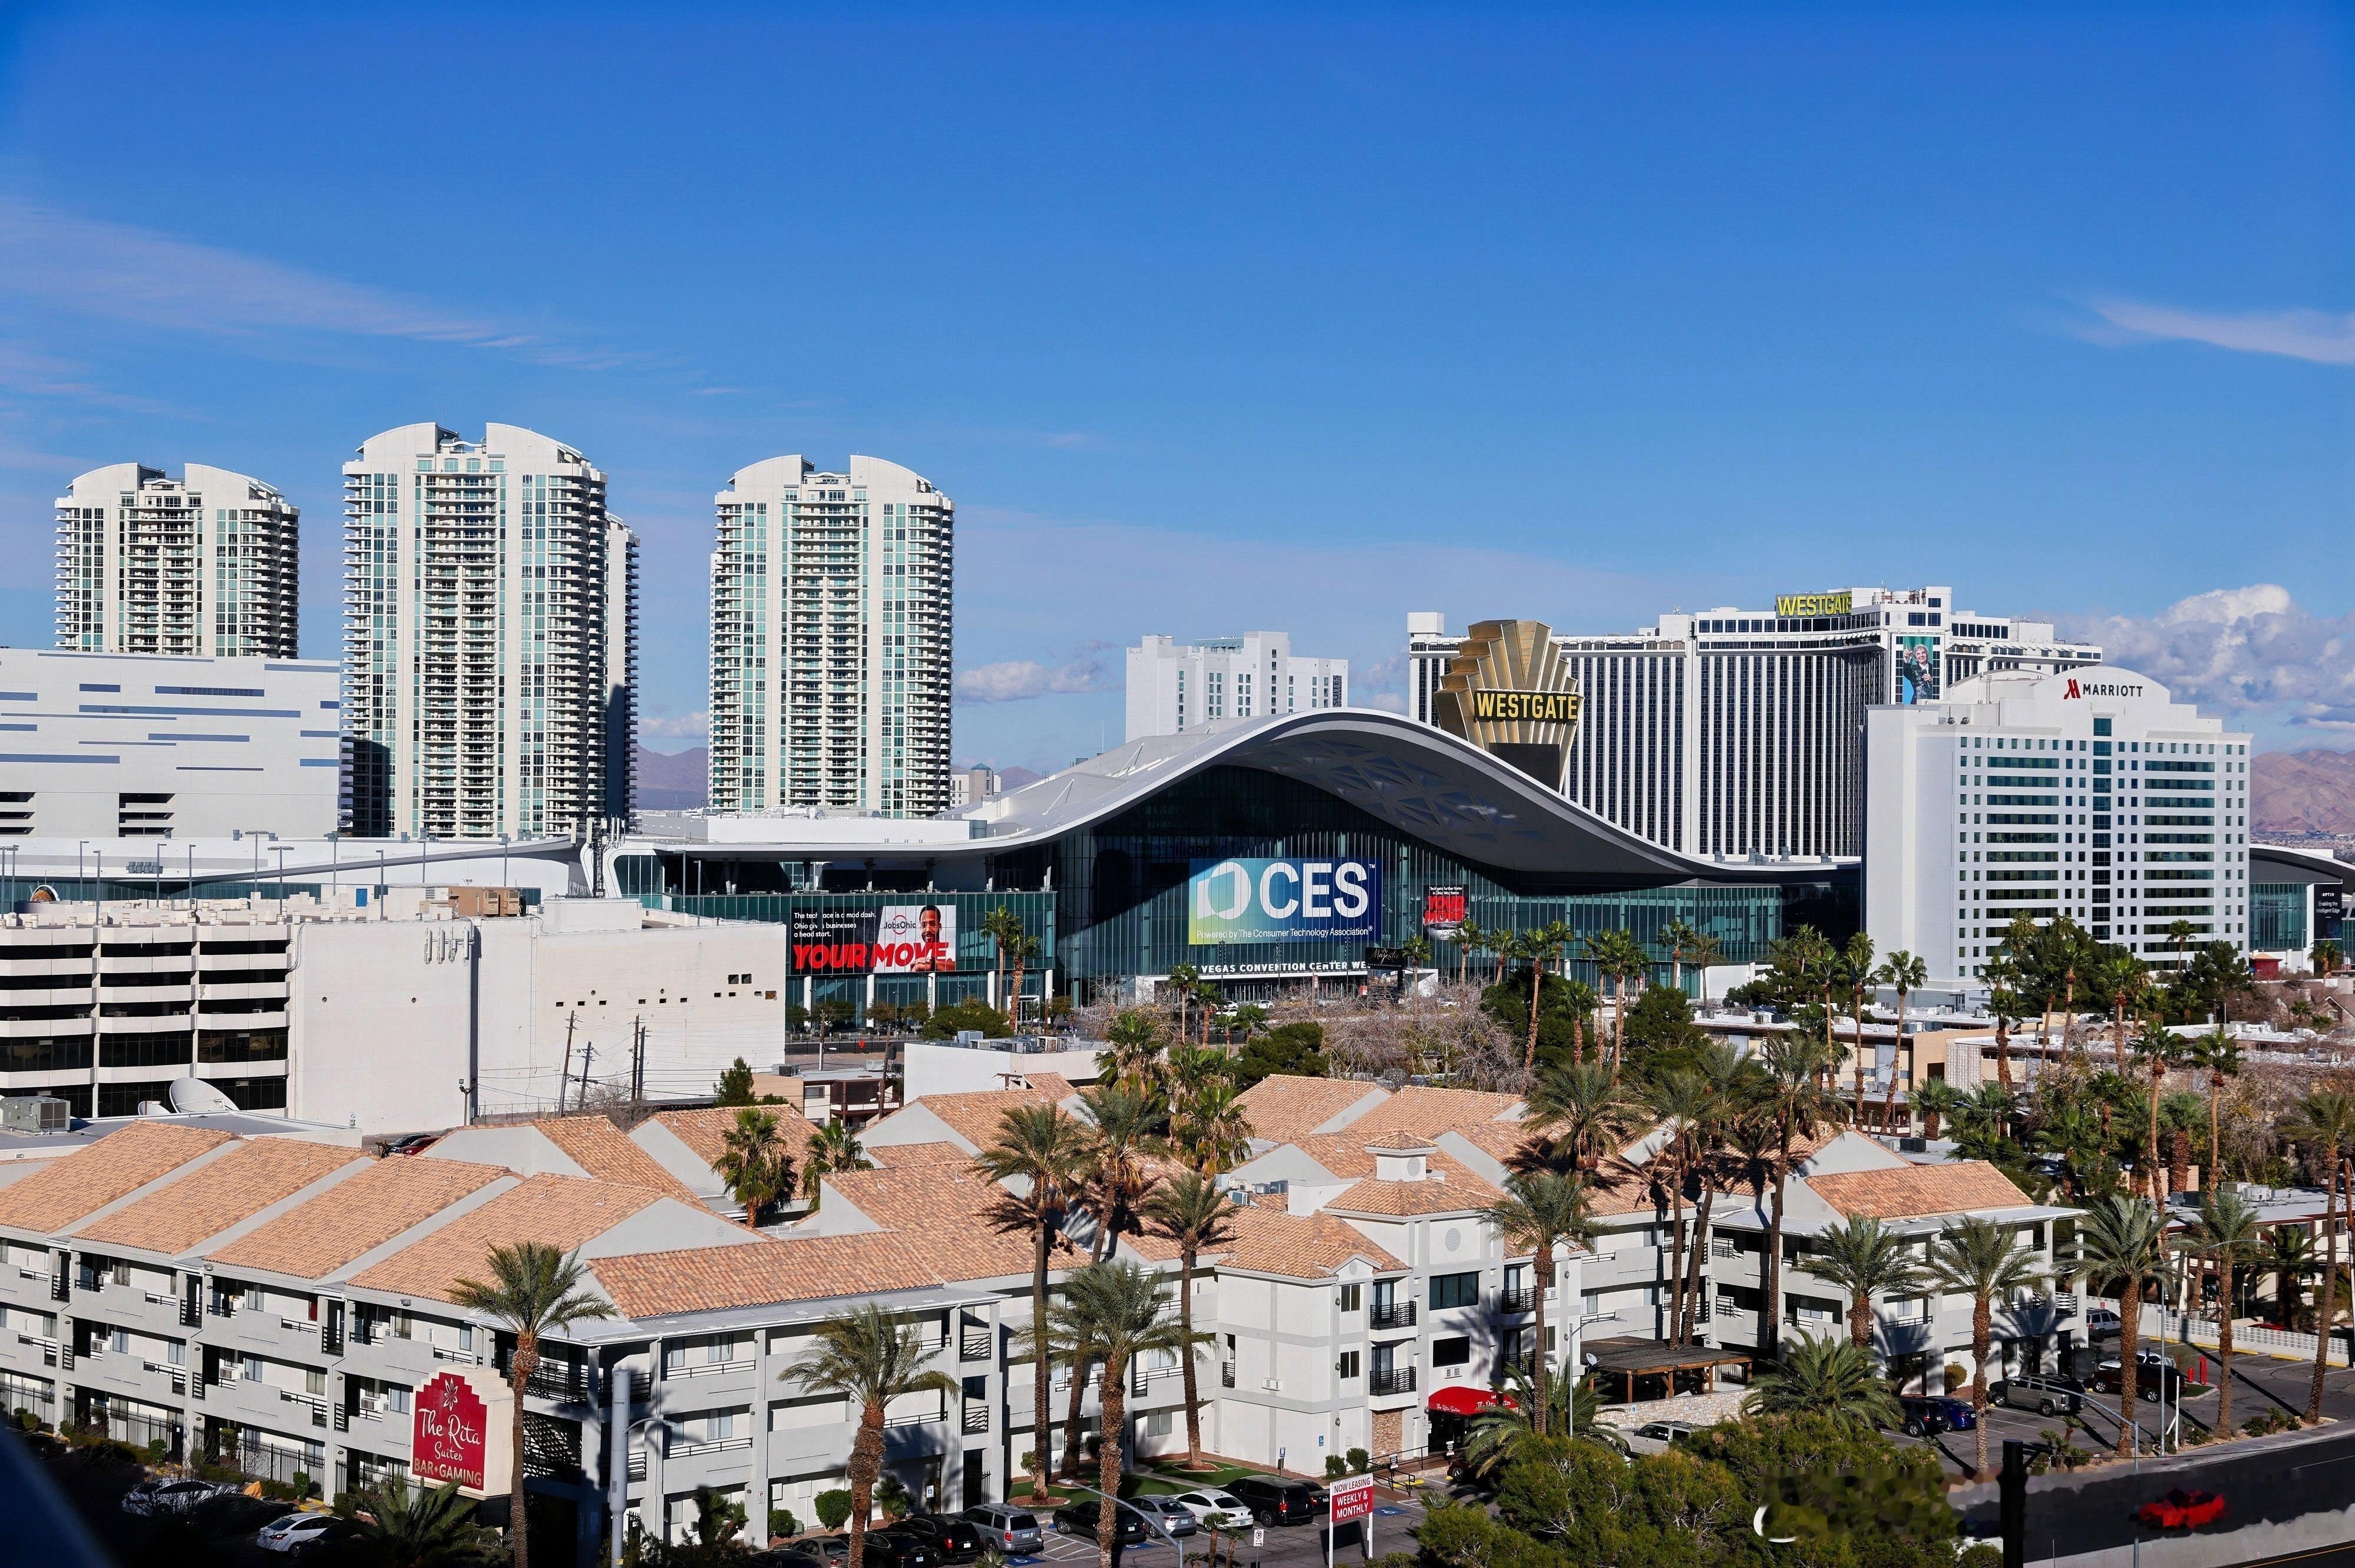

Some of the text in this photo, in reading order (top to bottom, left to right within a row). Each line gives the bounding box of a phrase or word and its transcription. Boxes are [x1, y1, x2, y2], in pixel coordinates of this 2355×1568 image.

[1778, 593, 1851, 616] WESTGATE
[2083, 683, 2143, 697] MARRIOTT
[1477, 693, 1577, 719] WESTGATE
[1260, 862, 1368, 918] CES
[1427, 895, 1464, 911] YOUR
[883, 921, 916, 929] JobsOhio
[1197, 930, 1227, 939] Powered
[1228, 929, 1237, 940] by
[1238, 928, 1252, 937] The
[1253, 928, 1289, 938] Consumer
[1290, 928, 1329, 938] Technology
[793, 943, 868, 969] YOUR
[1201, 965, 1236, 973] VEGAS
[1240, 962, 1306, 972] CONVENTION
[1309, 961, 1347, 970] CENTER
[418, 1407, 481, 1450] The Rita
[435, 1441, 463, 1461] Suites
[414, 1458, 481, 1486] BAR GAMING
[1334, 1477, 1370, 1493] NOW LEASING
[1337, 1490, 1368, 1506] WEEKLY &
[1336, 1502, 1369, 1519] MONTHLY
